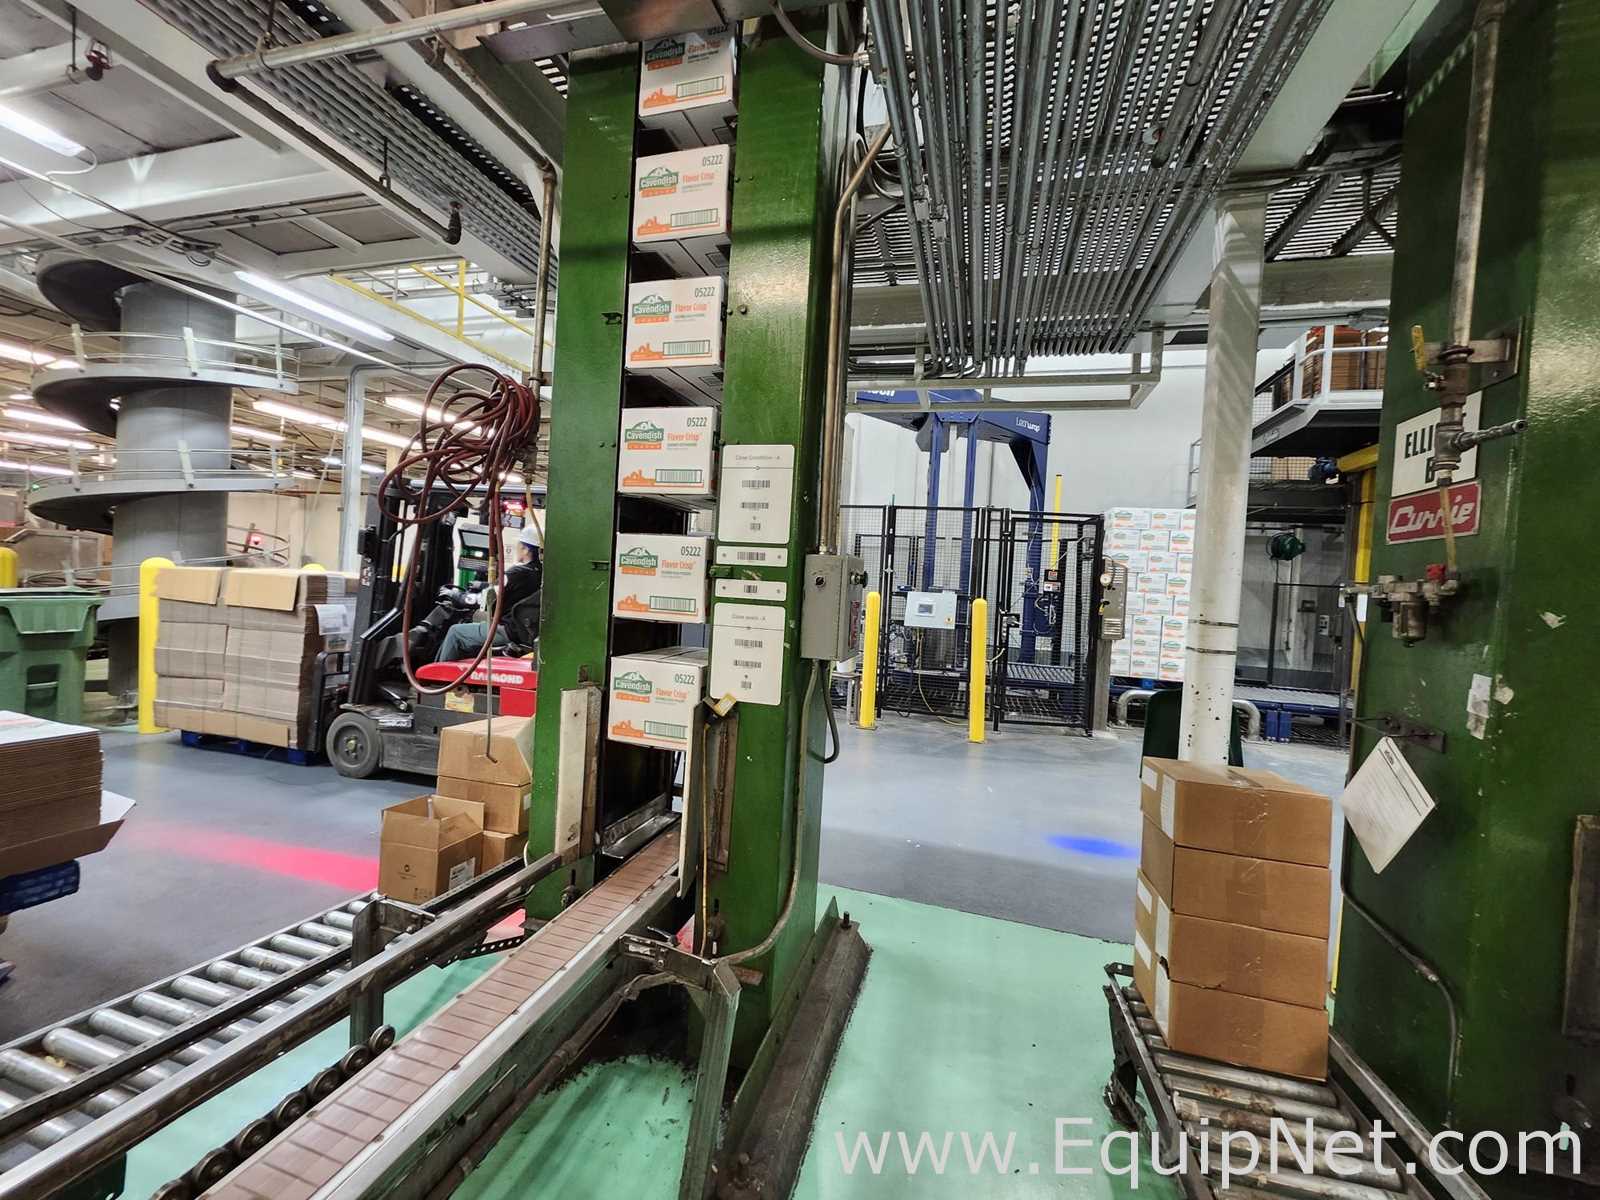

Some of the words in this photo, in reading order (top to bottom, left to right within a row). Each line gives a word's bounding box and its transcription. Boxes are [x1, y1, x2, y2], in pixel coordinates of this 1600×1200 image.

[646, 45, 684, 60] Cavendish
[702, 153, 723, 167] 05222
[640, 175, 678, 188] Cavendish
[694, 286, 715, 298] 05222
[633, 304, 670, 314] Cavendish
[687, 417, 707, 428] 05222
[626, 431, 662, 441] Cavendish
[1389, 495, 1475, 534] Currie
[681, 546, 701, 557] 05222
[620, 555, 656, 567] Cavendish
[471, 673, 524, 684] RAMOND
[674, 673, 695, 686] 05222
[615, 680, 651, 692] Cavendish
